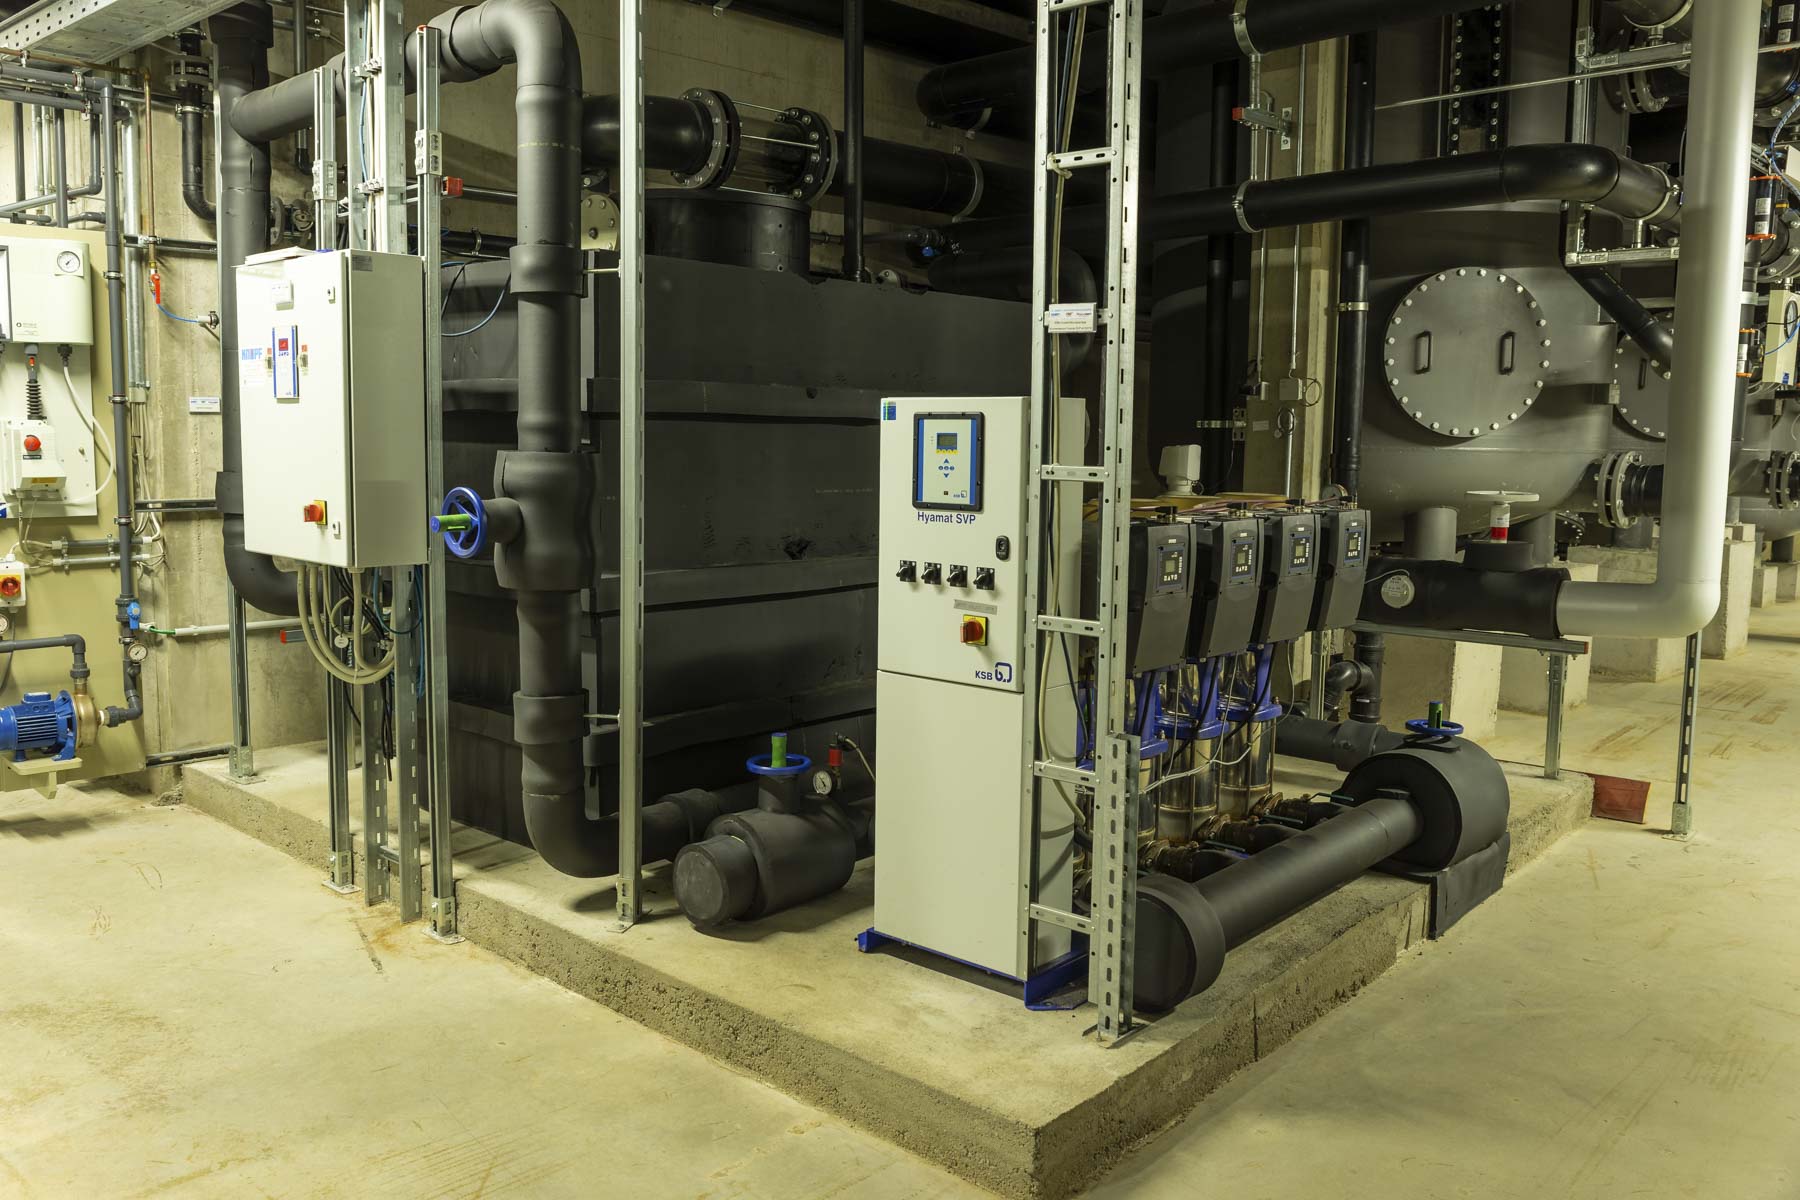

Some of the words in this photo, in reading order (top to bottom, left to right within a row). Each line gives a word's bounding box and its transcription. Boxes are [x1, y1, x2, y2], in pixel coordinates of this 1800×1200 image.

[917, 511, 953, 524] Hyamat
[956, 513, 976, 524] SVP
[975, 670, 993, 681] KSB
